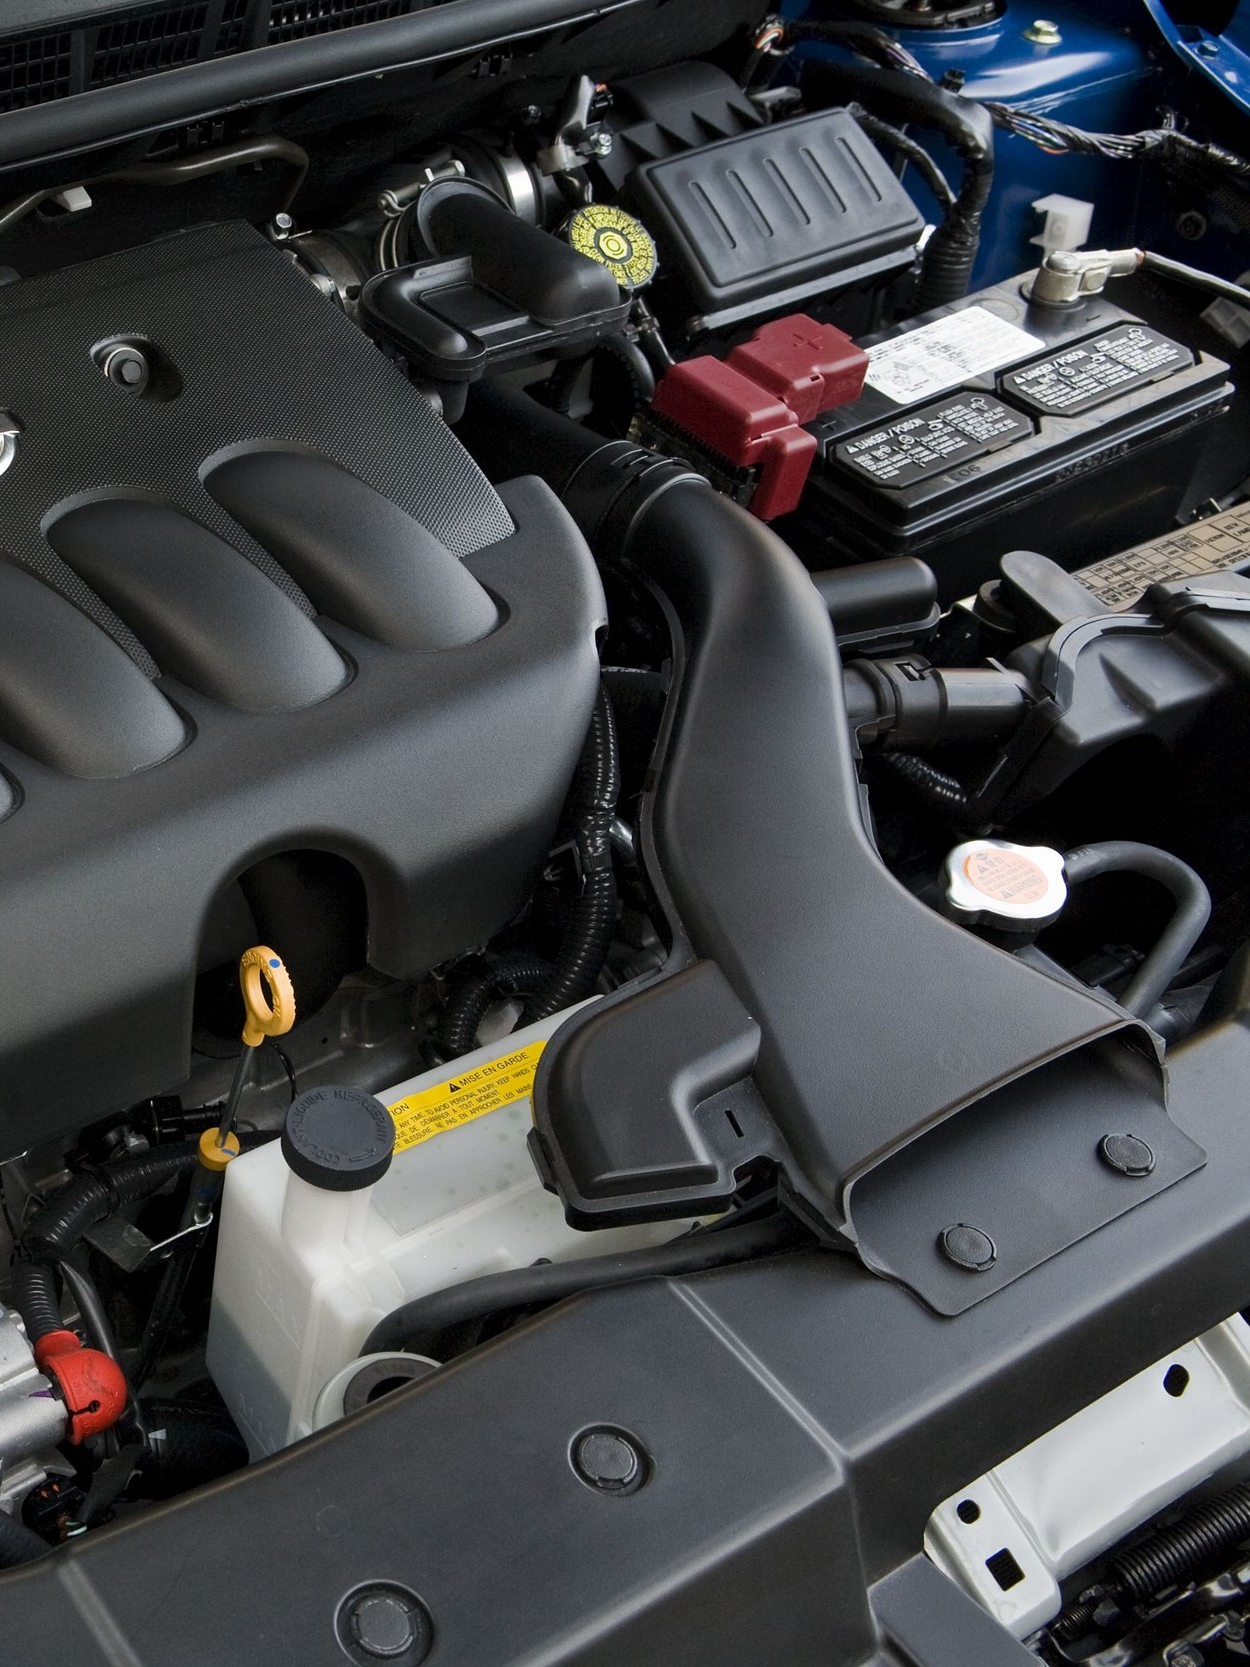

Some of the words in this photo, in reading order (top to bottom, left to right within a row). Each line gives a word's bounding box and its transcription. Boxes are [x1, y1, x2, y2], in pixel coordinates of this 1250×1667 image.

[855, 432, 890, 451] DANGER
[893, 417, 926, 435] POISON
[459, 1072, 483, 1086] MISE
[482, 1066, 497, 1076] EN
[496, 1051, 529, 1070] GARDE
[399, 1120, 410, 1129] ANY
[410, 1112, 426, 1122] TIME
[434, 1102, 451, 1113] AVOID
[450, 1090, 478, 1106] PERSONAL
[496, 1075, 511, 1085] KEEP
[511, 1068, 530, 1079] HANDS
[403, 1127, 433, 1144] BLESSURE
[445, 1117, 458, 1125] PAS
[459, 1112, 469, 1120] EN
[469, 1097, 502, 1115] APPROCHER
[503, 1091, 515, 1100] LES
[409, 1125, 419, 1133] DE
[459, 1101, 474, 1111] TOUT
